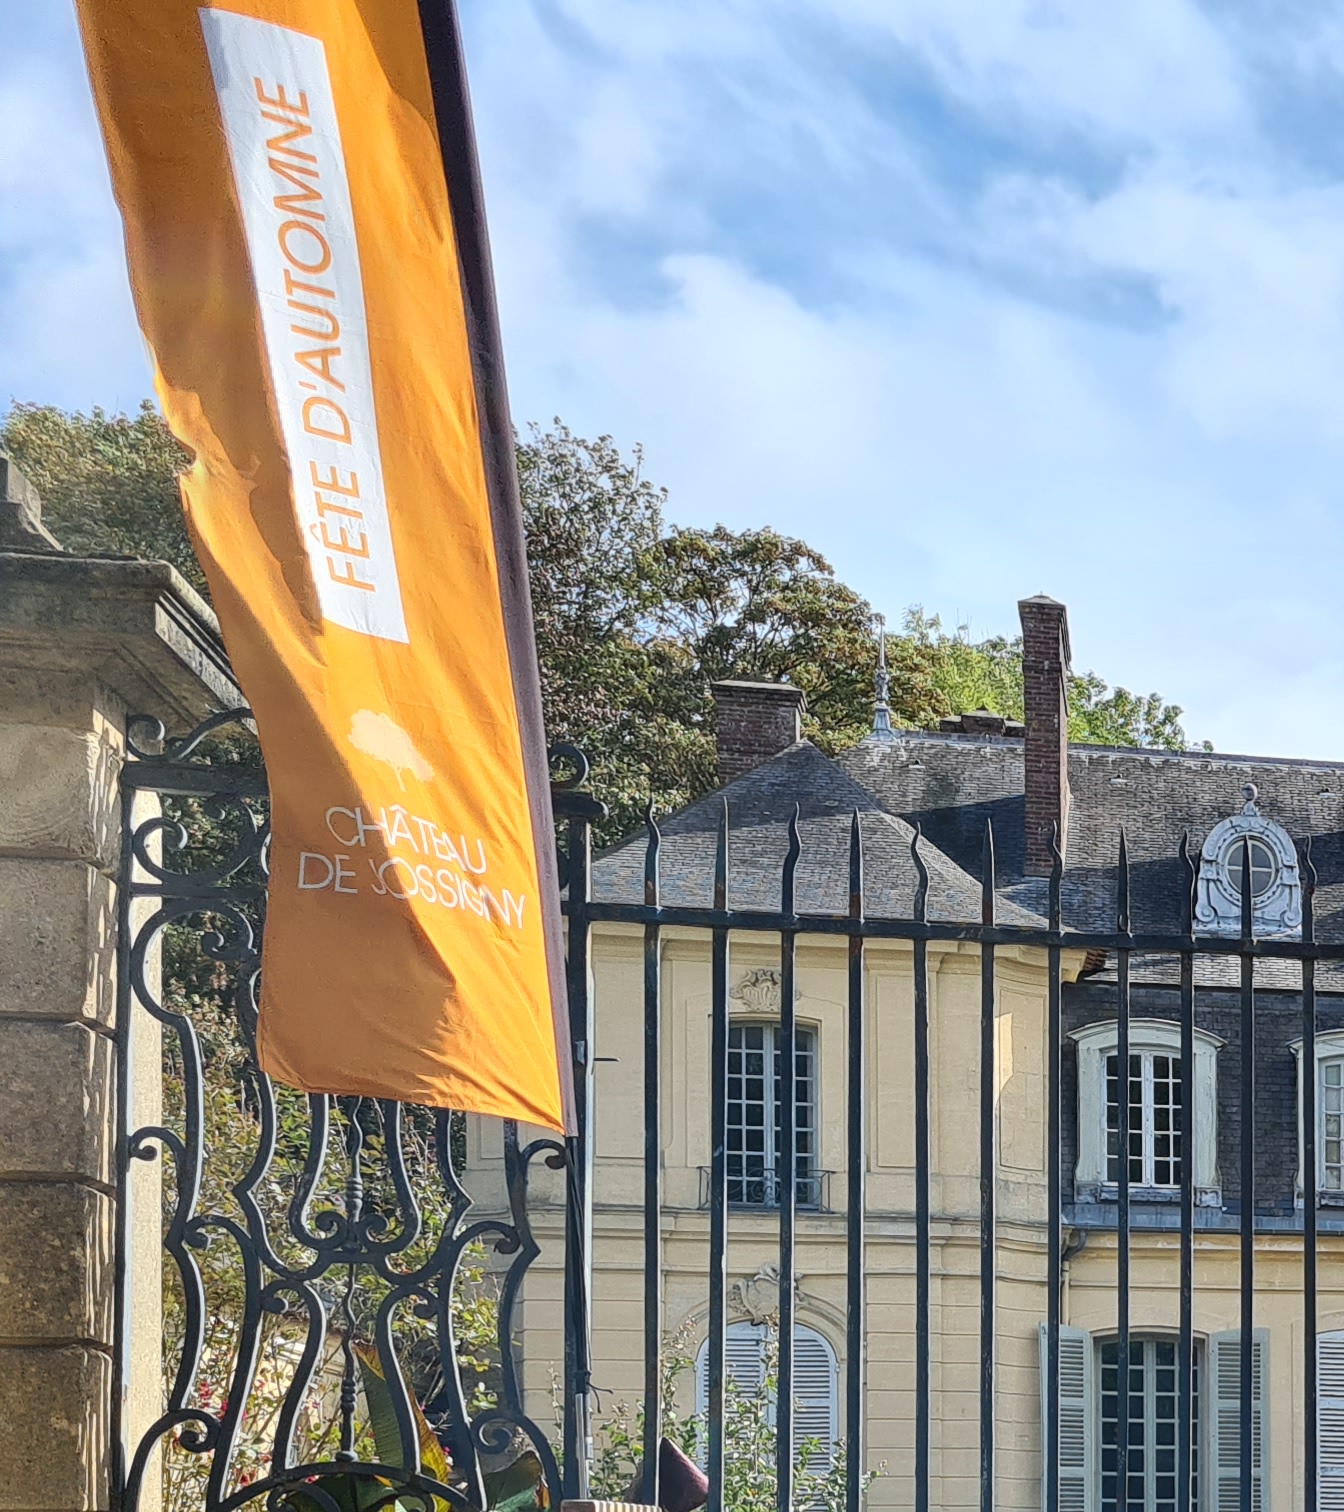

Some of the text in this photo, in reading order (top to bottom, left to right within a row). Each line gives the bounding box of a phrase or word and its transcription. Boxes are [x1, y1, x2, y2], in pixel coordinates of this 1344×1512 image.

[253, 76, 377, 593] FÊTE D'AUTOMNE
[325, 804, 488, 875] CHÂTEAU
[298, 851, 526, 930] DE JOSSIGNY
